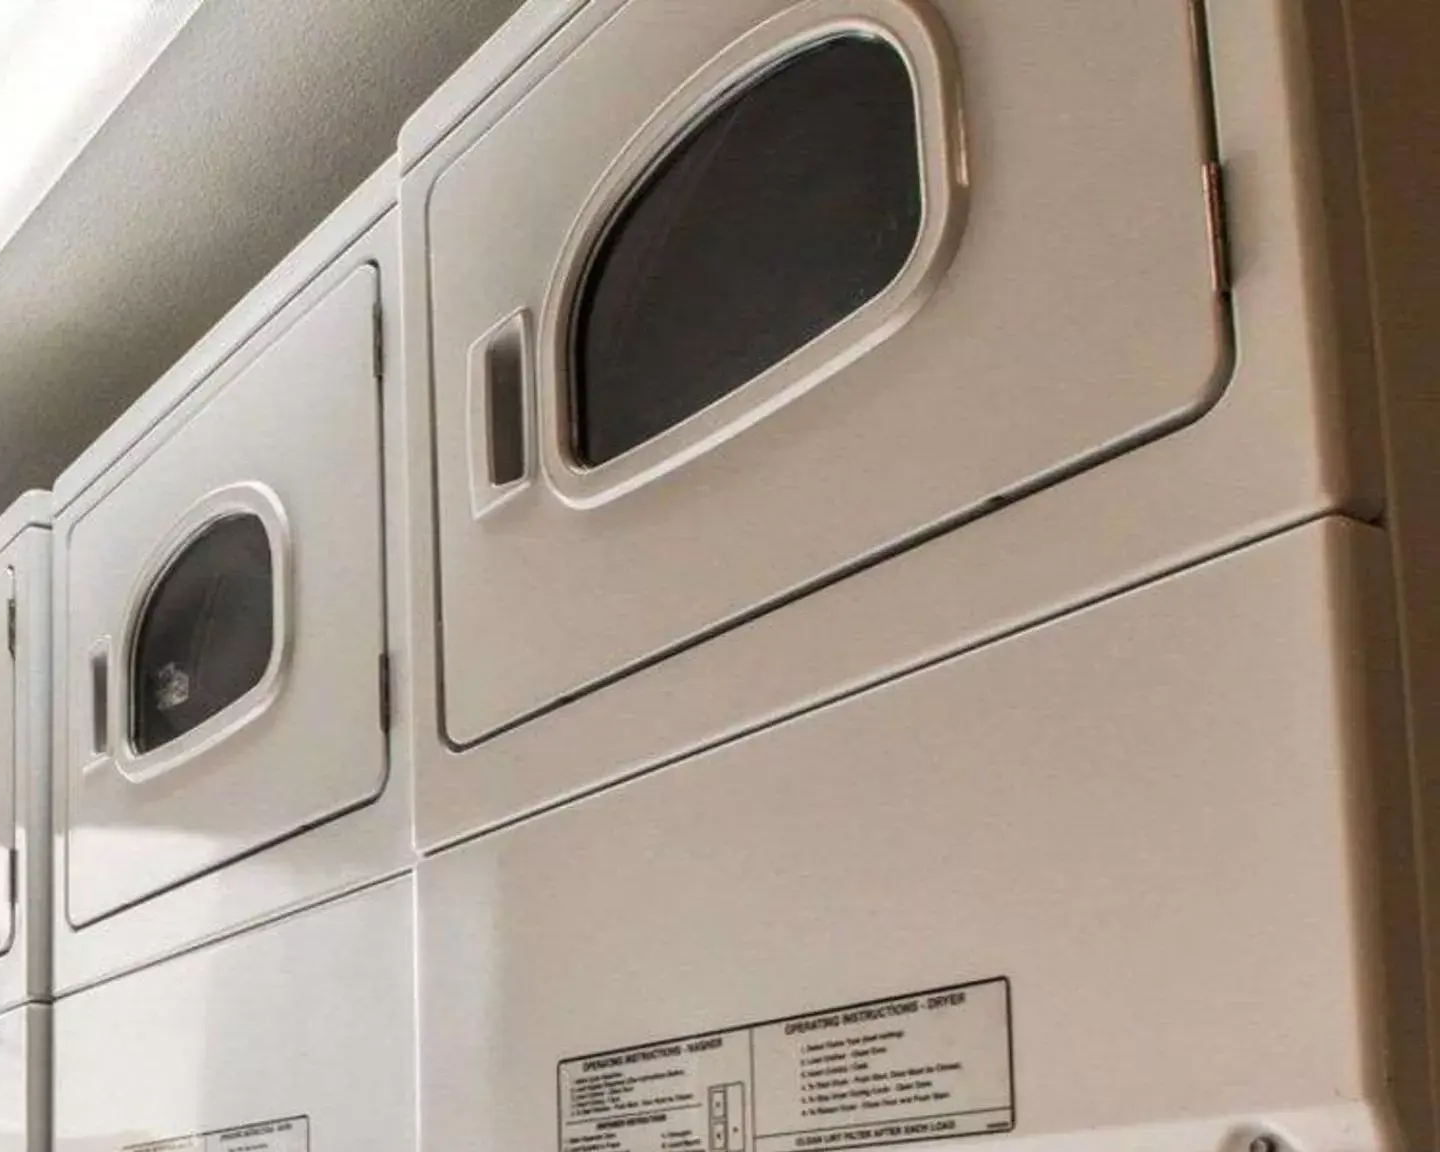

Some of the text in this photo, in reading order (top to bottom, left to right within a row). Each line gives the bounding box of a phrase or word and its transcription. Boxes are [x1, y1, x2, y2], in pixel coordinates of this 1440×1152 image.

[784, 1014, 840, 1035] OPERATING
[841, 1000, 918, 1026] INSTRUCTIONS
[926, 992, 966, 1009] DRYER
[874, 1126, 902, 1136] AFTER
[930, 1119, 956, 1132] LOAD
